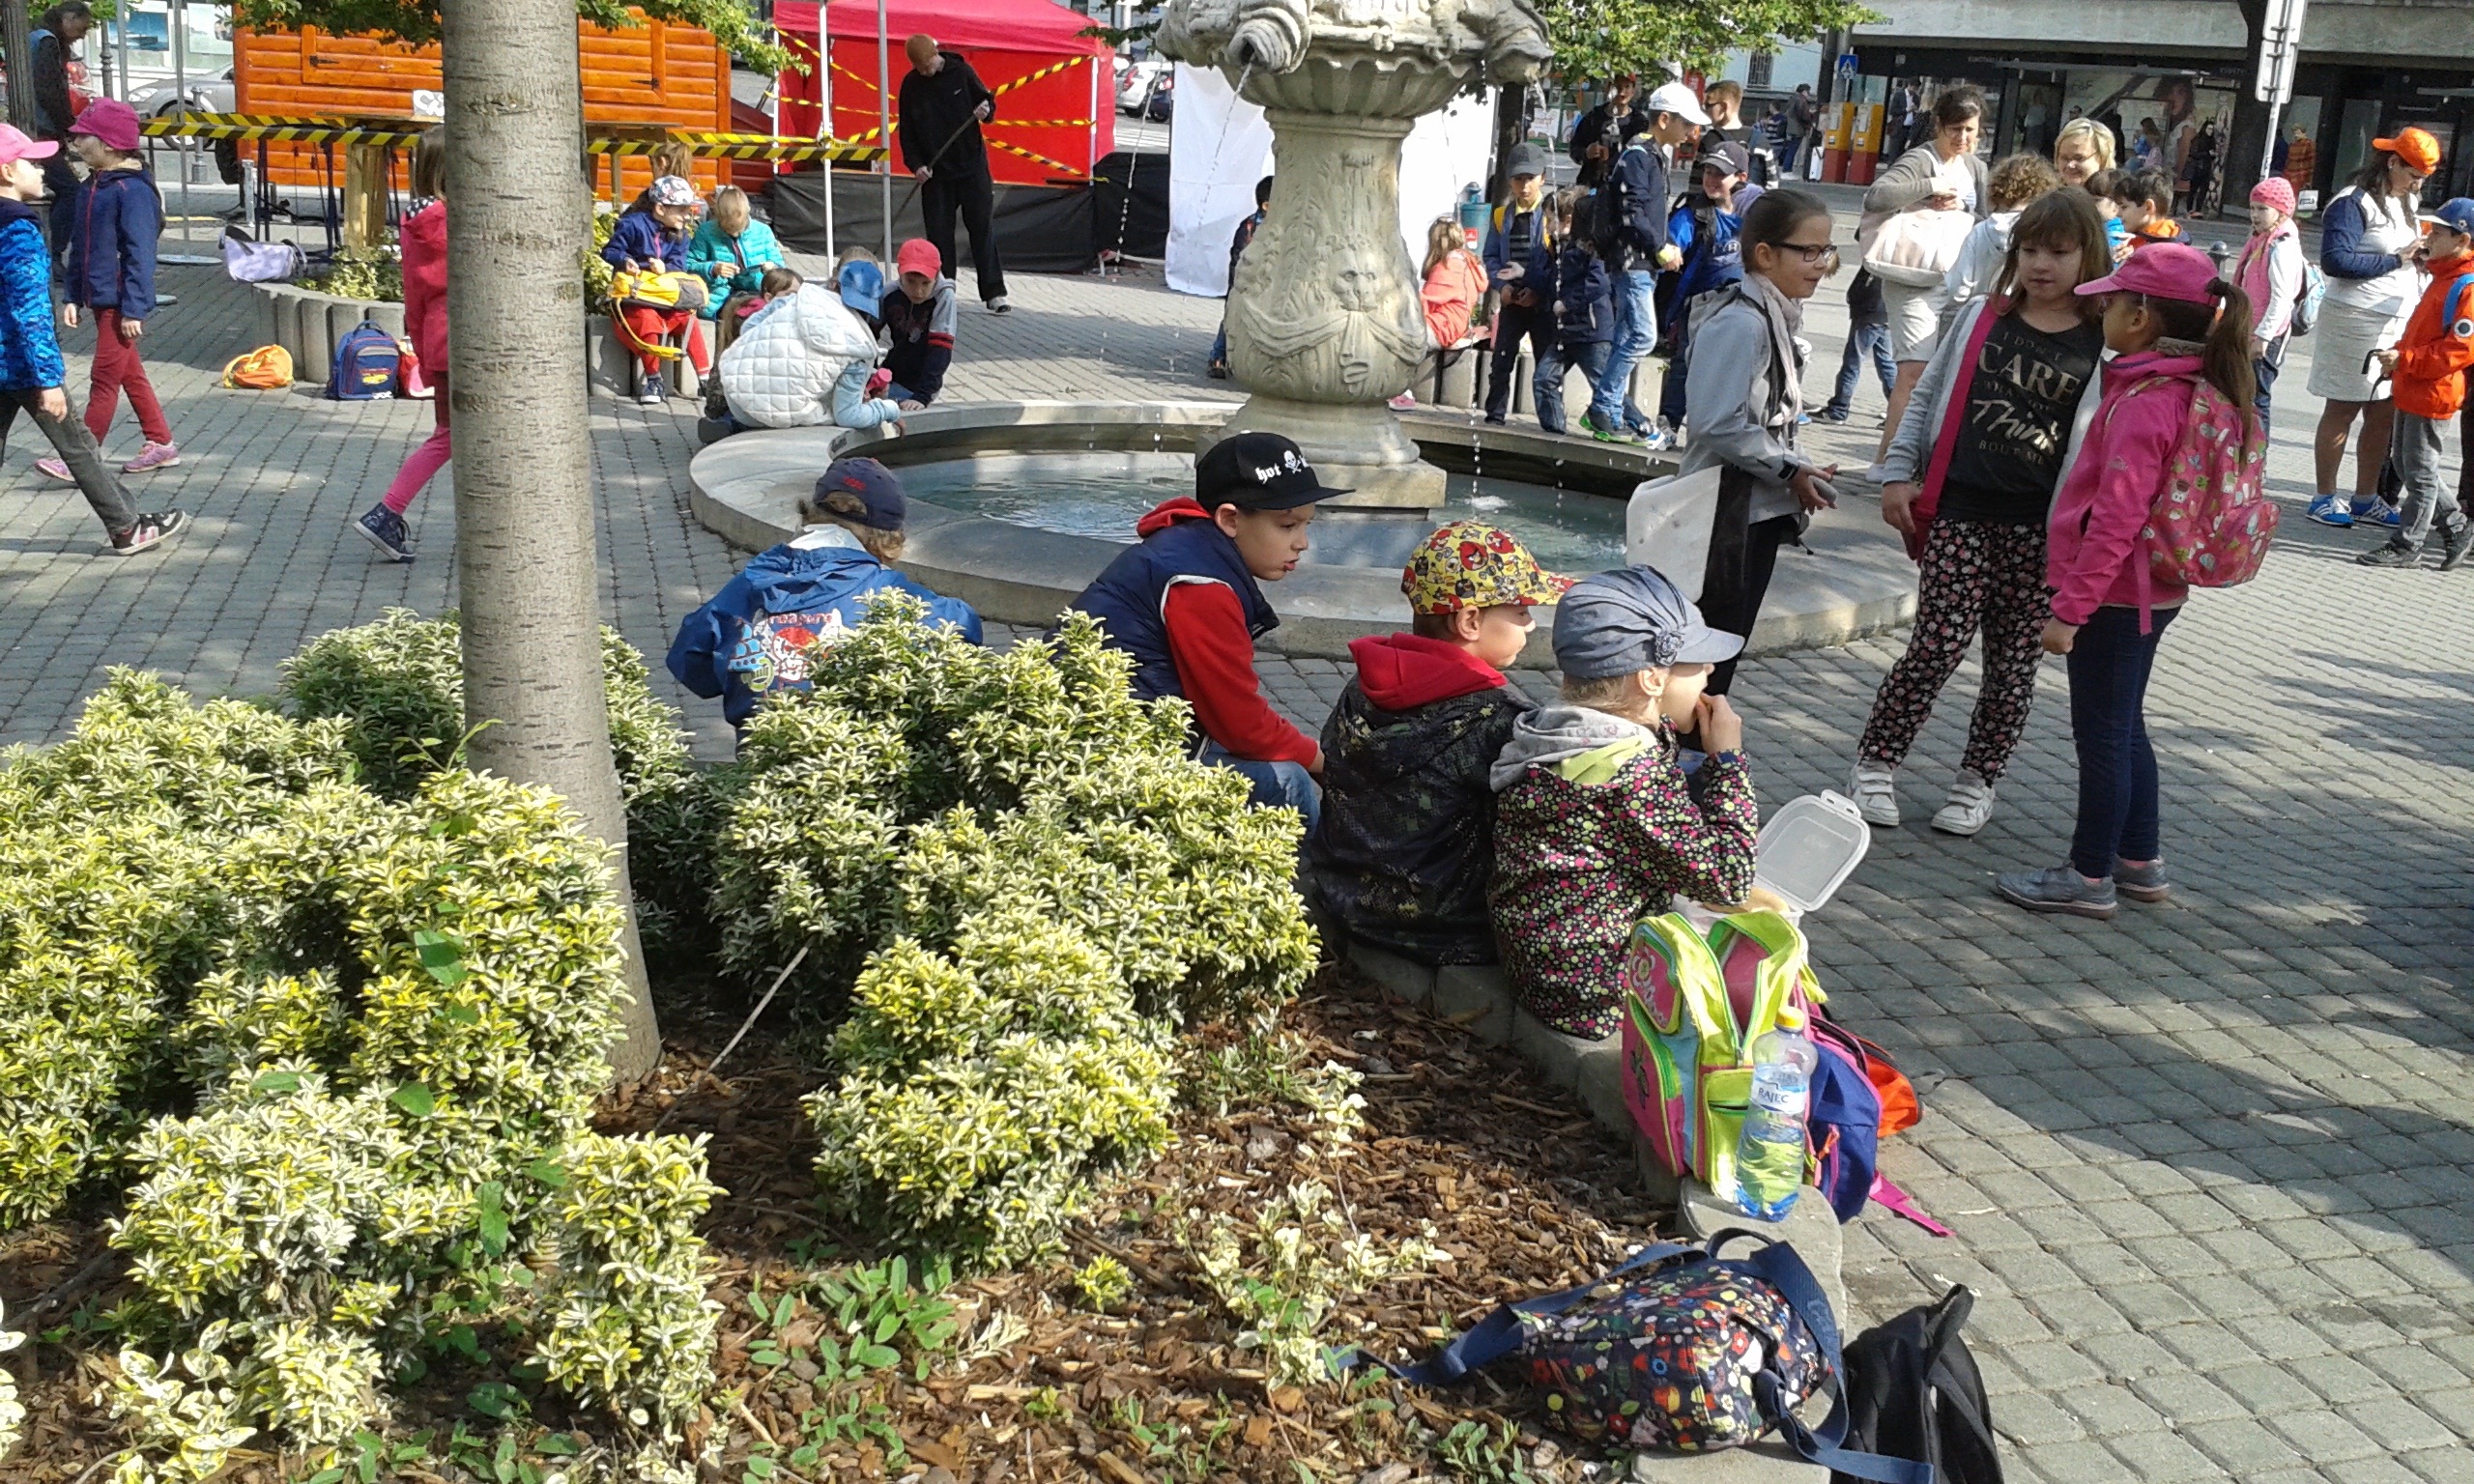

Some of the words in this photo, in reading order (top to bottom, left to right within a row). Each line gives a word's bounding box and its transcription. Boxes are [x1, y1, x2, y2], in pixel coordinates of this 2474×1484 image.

[1978, 341, 2081, 406] CARE
[1972, 398, 2061, 456] Think
[1254, 462, 1282, 485] hot
[1758, 1087, 1790, 1103] RAJEC
